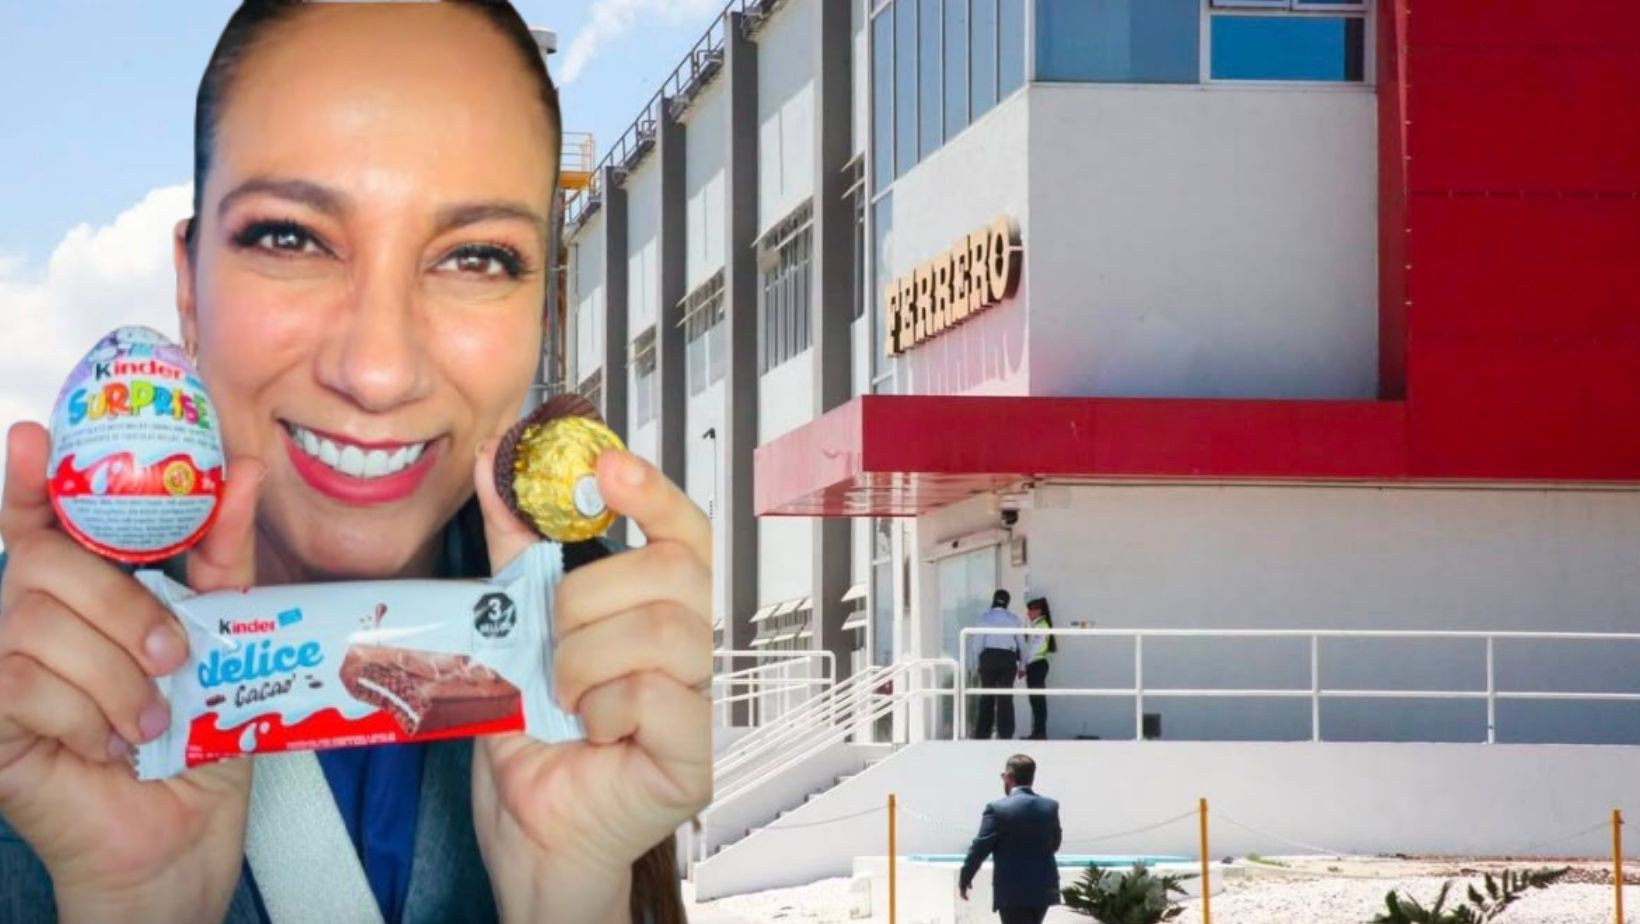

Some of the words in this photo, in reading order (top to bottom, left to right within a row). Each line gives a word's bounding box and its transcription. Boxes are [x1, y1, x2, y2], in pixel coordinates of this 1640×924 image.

[885, 212, 1014, 356] FERRERO
[94, 359, 182, 381] Kinder
[67, 379, 211, 430] SURPRISE
[487, 597, 503, 621] 3
[218, 618, 276, 636] Kinder
